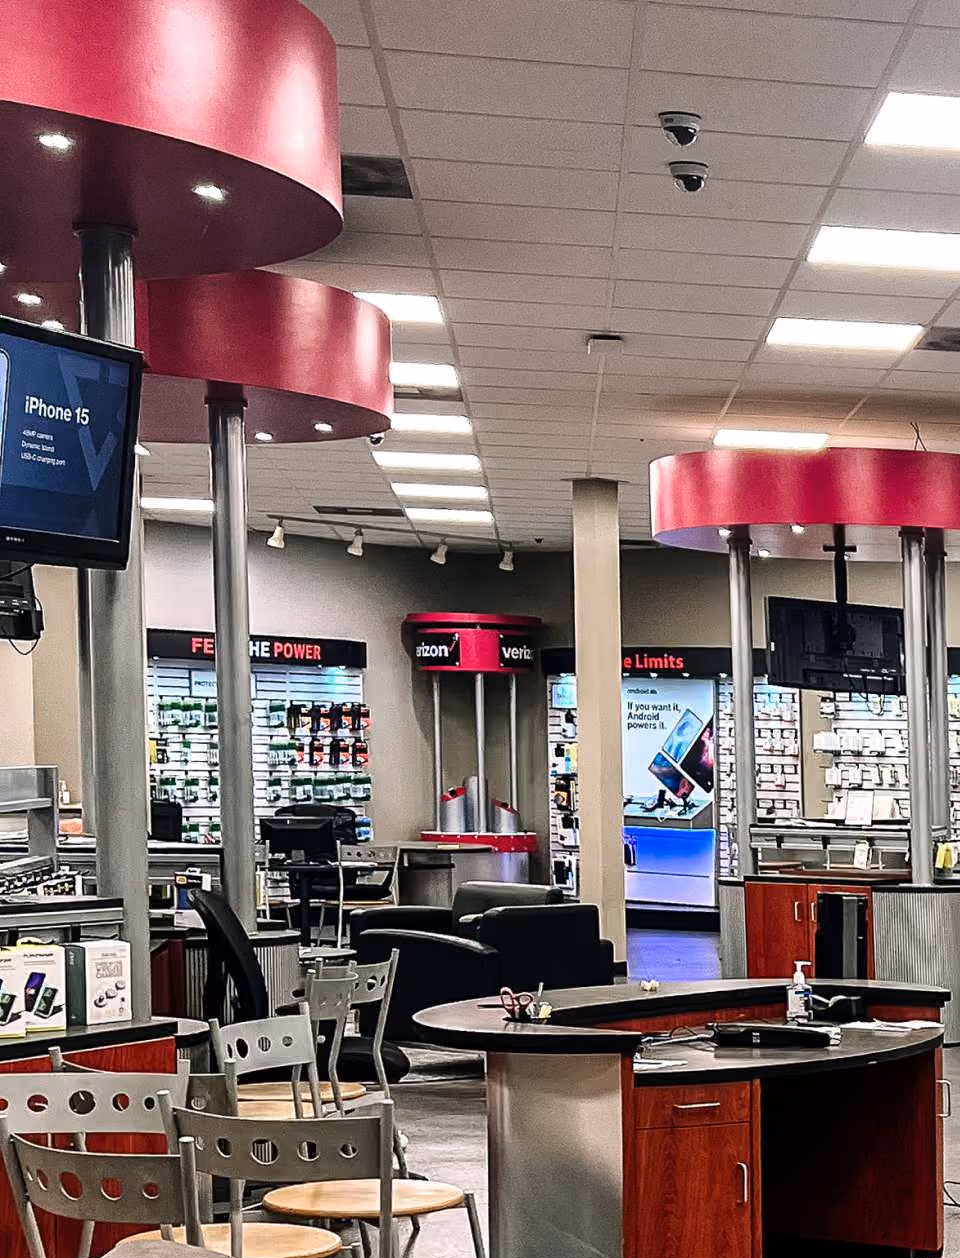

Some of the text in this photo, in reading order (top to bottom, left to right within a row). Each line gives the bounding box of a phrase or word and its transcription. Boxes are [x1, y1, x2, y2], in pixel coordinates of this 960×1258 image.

[25, 395, 90, 425] iPhone 15
[249, 641, 271, 657] HE
[273, 642, 321, 661] POWER
[635, 653, 684, 669] Limits
[627, 702, 633, 710] If
[635, 704, 650, 712] you
[673, 703, 681, 713] it,
[628, 712, 660, 721] Android
[627, 721, 668, 730] powers it.
